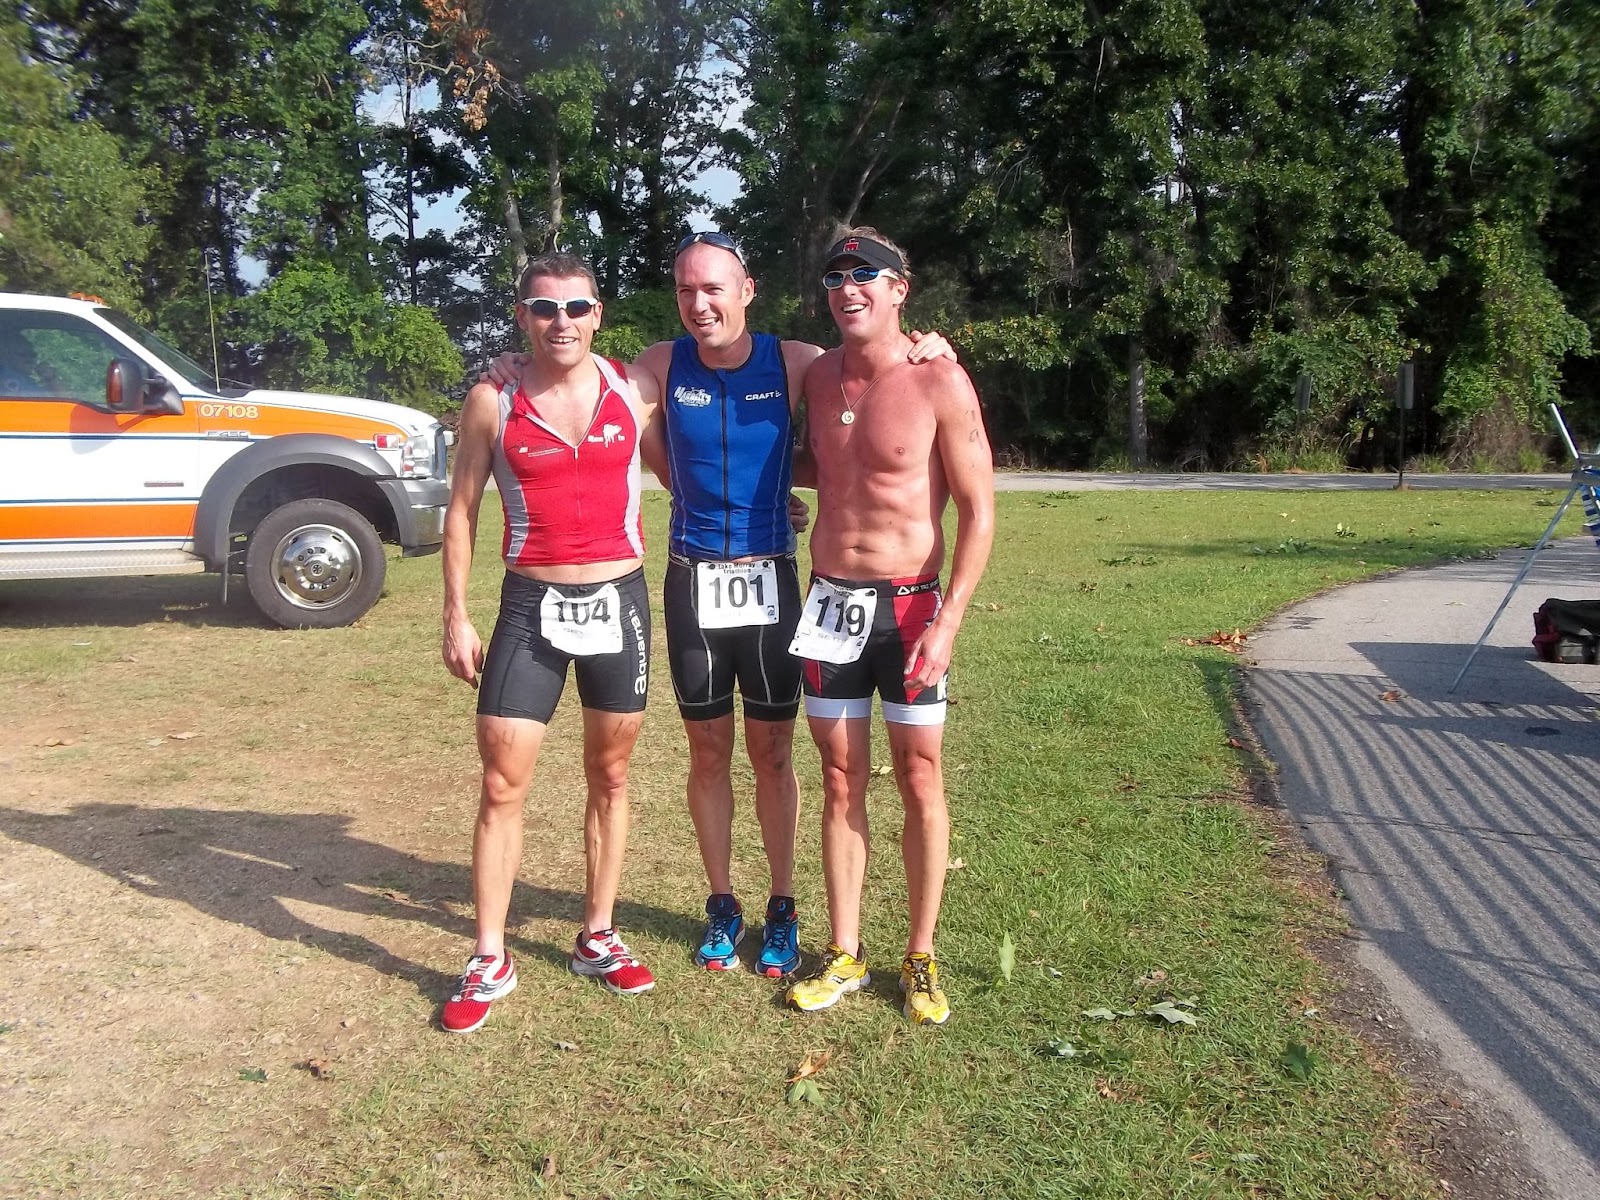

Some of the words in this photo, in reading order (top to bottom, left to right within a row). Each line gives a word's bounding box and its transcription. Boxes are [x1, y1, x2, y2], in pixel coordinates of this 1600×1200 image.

[200, 403, 259, 419] 07108
[745, 391, 775, 401] CRAFT
[709, 574, 764, 609] 101
[553, 596, 611, 626] 104
[815, 595, 866, 637] 119
